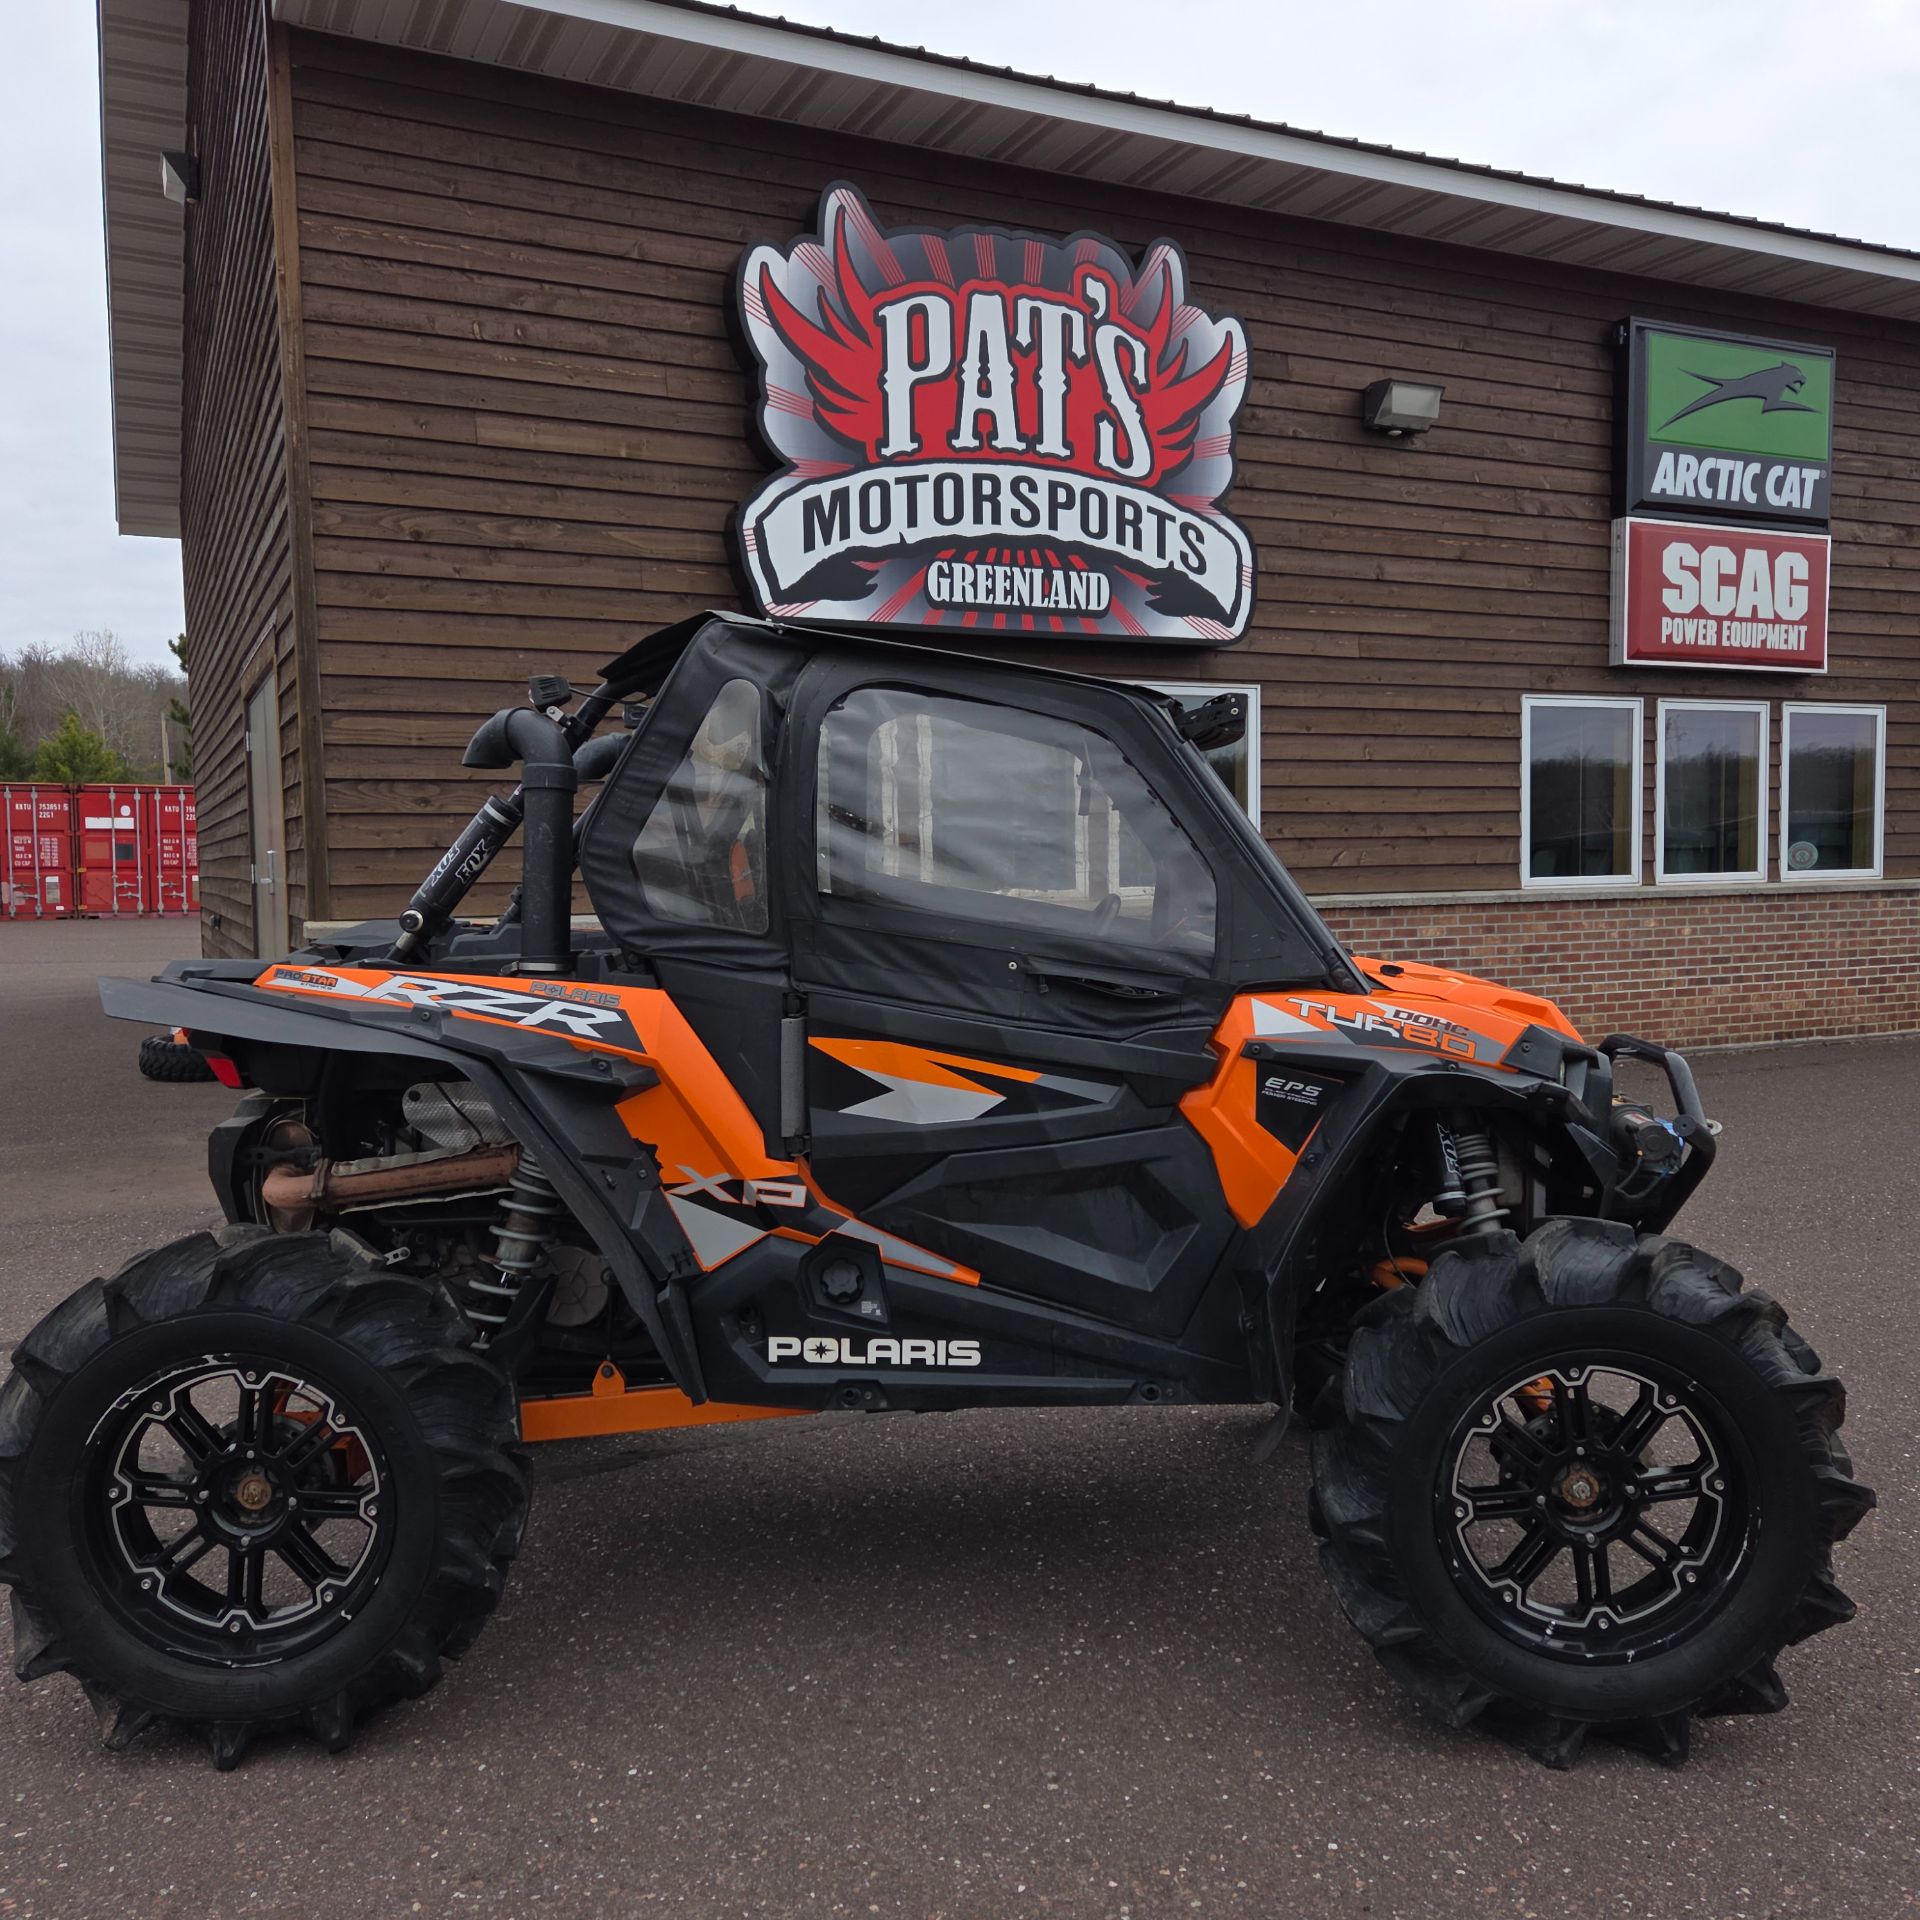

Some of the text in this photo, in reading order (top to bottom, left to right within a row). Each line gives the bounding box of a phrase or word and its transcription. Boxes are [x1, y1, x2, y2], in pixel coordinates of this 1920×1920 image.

[878, 275, 1152, 478] PAT'S
[1651, 452, 1820, 510] ARCTIC CAT
[802, 471, 1208, 577] MOTORSPORTS
[927, 560, 1110, 613] GREENLAND
[1662, 541, 1809, 622] SCAG
[1661, 617, 1808, 651] POWER EQUIPMENT
[455, 838, 490, 885] FOX
[364, 975, 623, 1039] RZR
[530, 981, 621, 1007] POLARIS
[1285, 997, 1476, 1059] TURBO
[1392, 1008, 1470, 1037] DOHC
[1264, 1076, 1323, 1097] EPS
[666, 1164, 807, 1208] XP
[767, 1336, 982, 1367] POLARIS
